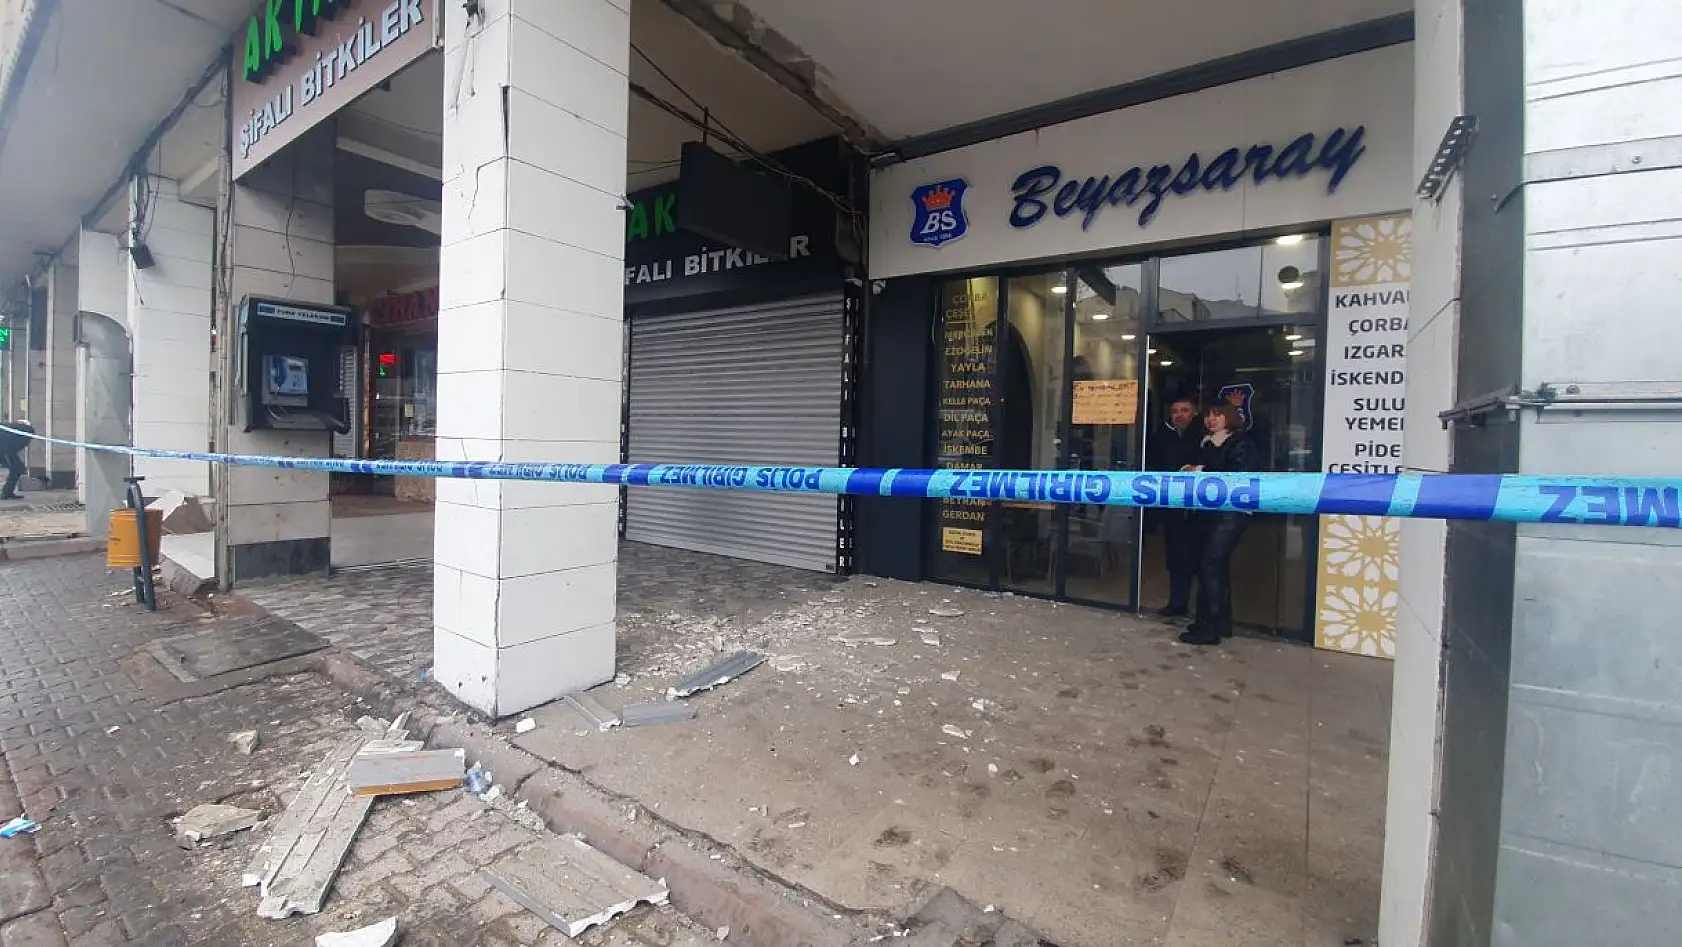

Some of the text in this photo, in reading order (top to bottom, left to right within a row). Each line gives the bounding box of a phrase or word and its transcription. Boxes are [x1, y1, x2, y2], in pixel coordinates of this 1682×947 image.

[240, 0, 424, 158] ŞİFALI BİTKİLER
[1010, 125, 1366, 231] Beyazsaray
[920, 210, 957, 233] BS
[1335, 290, 1410, 309] KAHVA
[1330, 370, 1403, 386] İSKEND
[1353, 398, 1405, 411] SULU
[1345, 417, 1404, 431] YEME
[1354, 440, 1401, 458] PİDE
[949, 471, 1261, 510] POLIS GIRILMEZ
[942, 510, 985, 521] GERDAN
